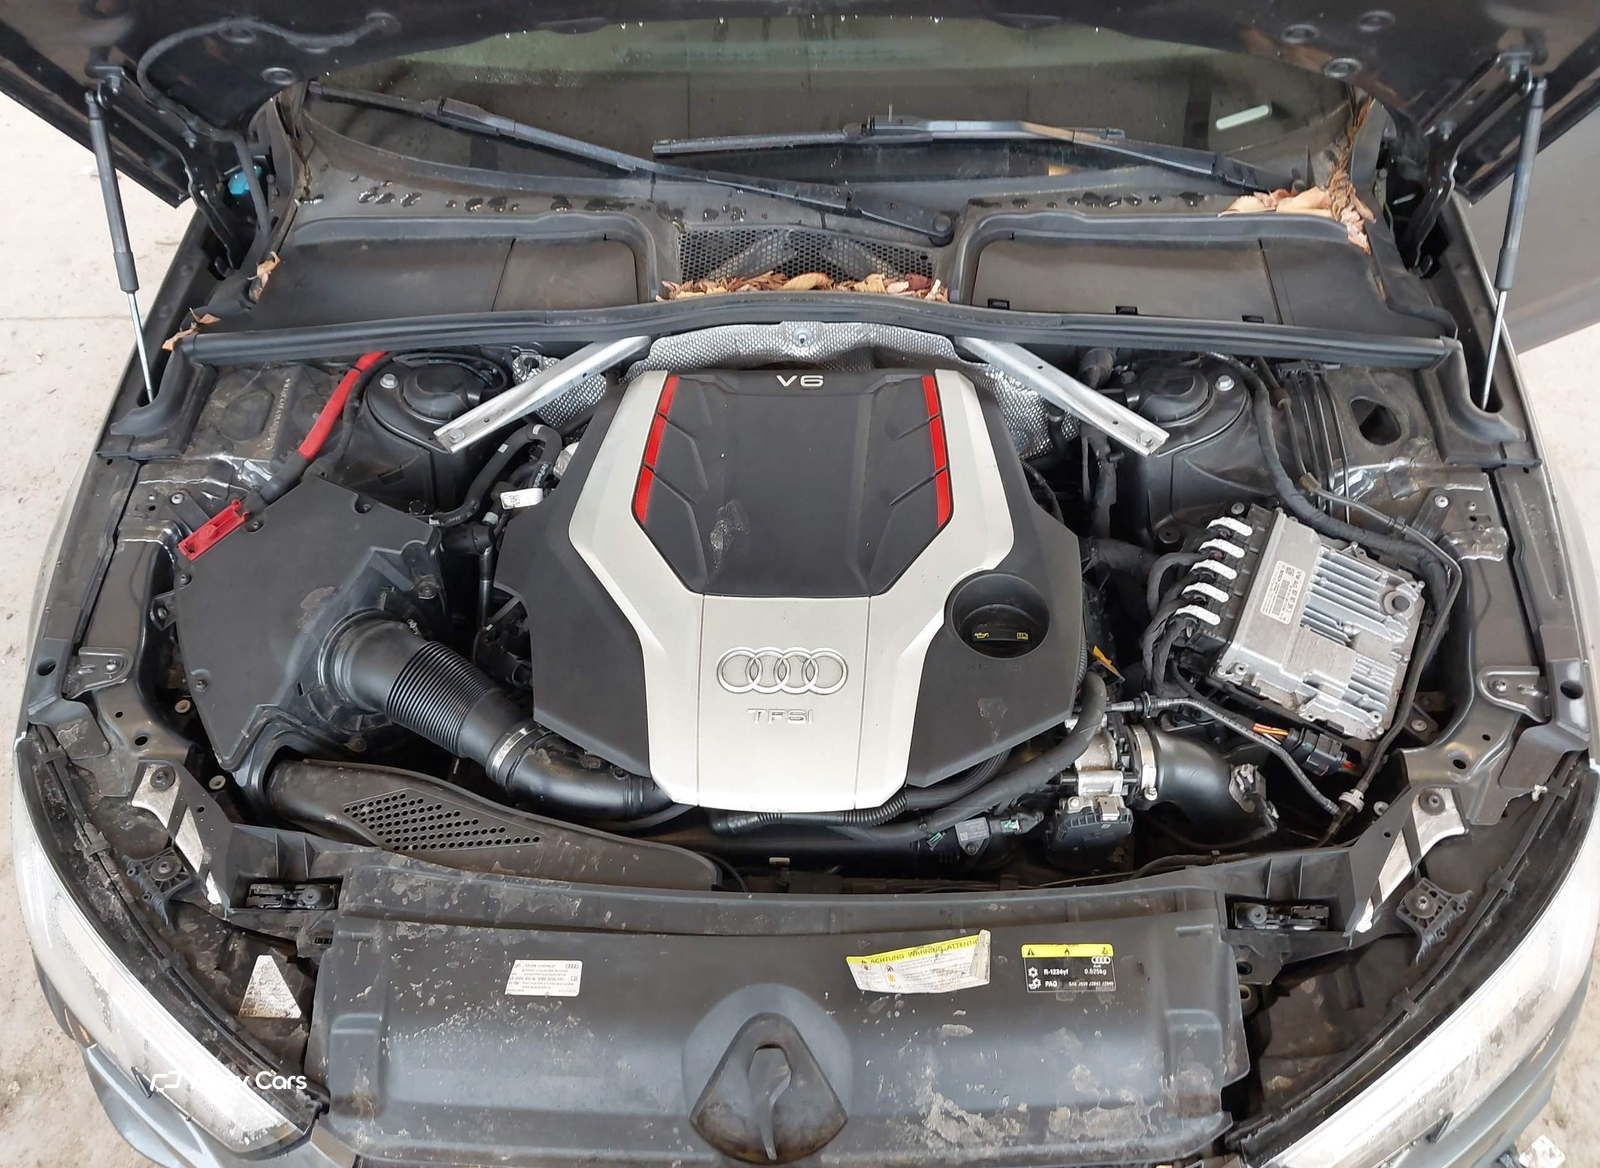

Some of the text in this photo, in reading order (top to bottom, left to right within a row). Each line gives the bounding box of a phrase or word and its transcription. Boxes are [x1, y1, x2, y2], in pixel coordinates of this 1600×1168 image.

[776, 374, 824, 387] V6
[746, 708, 813, 724] TFSI
[870, 954, 905, 964] ACHTUNG
[907, 946, 943, 959] WARNING
[1045, 980, 1058, 988] PAG
